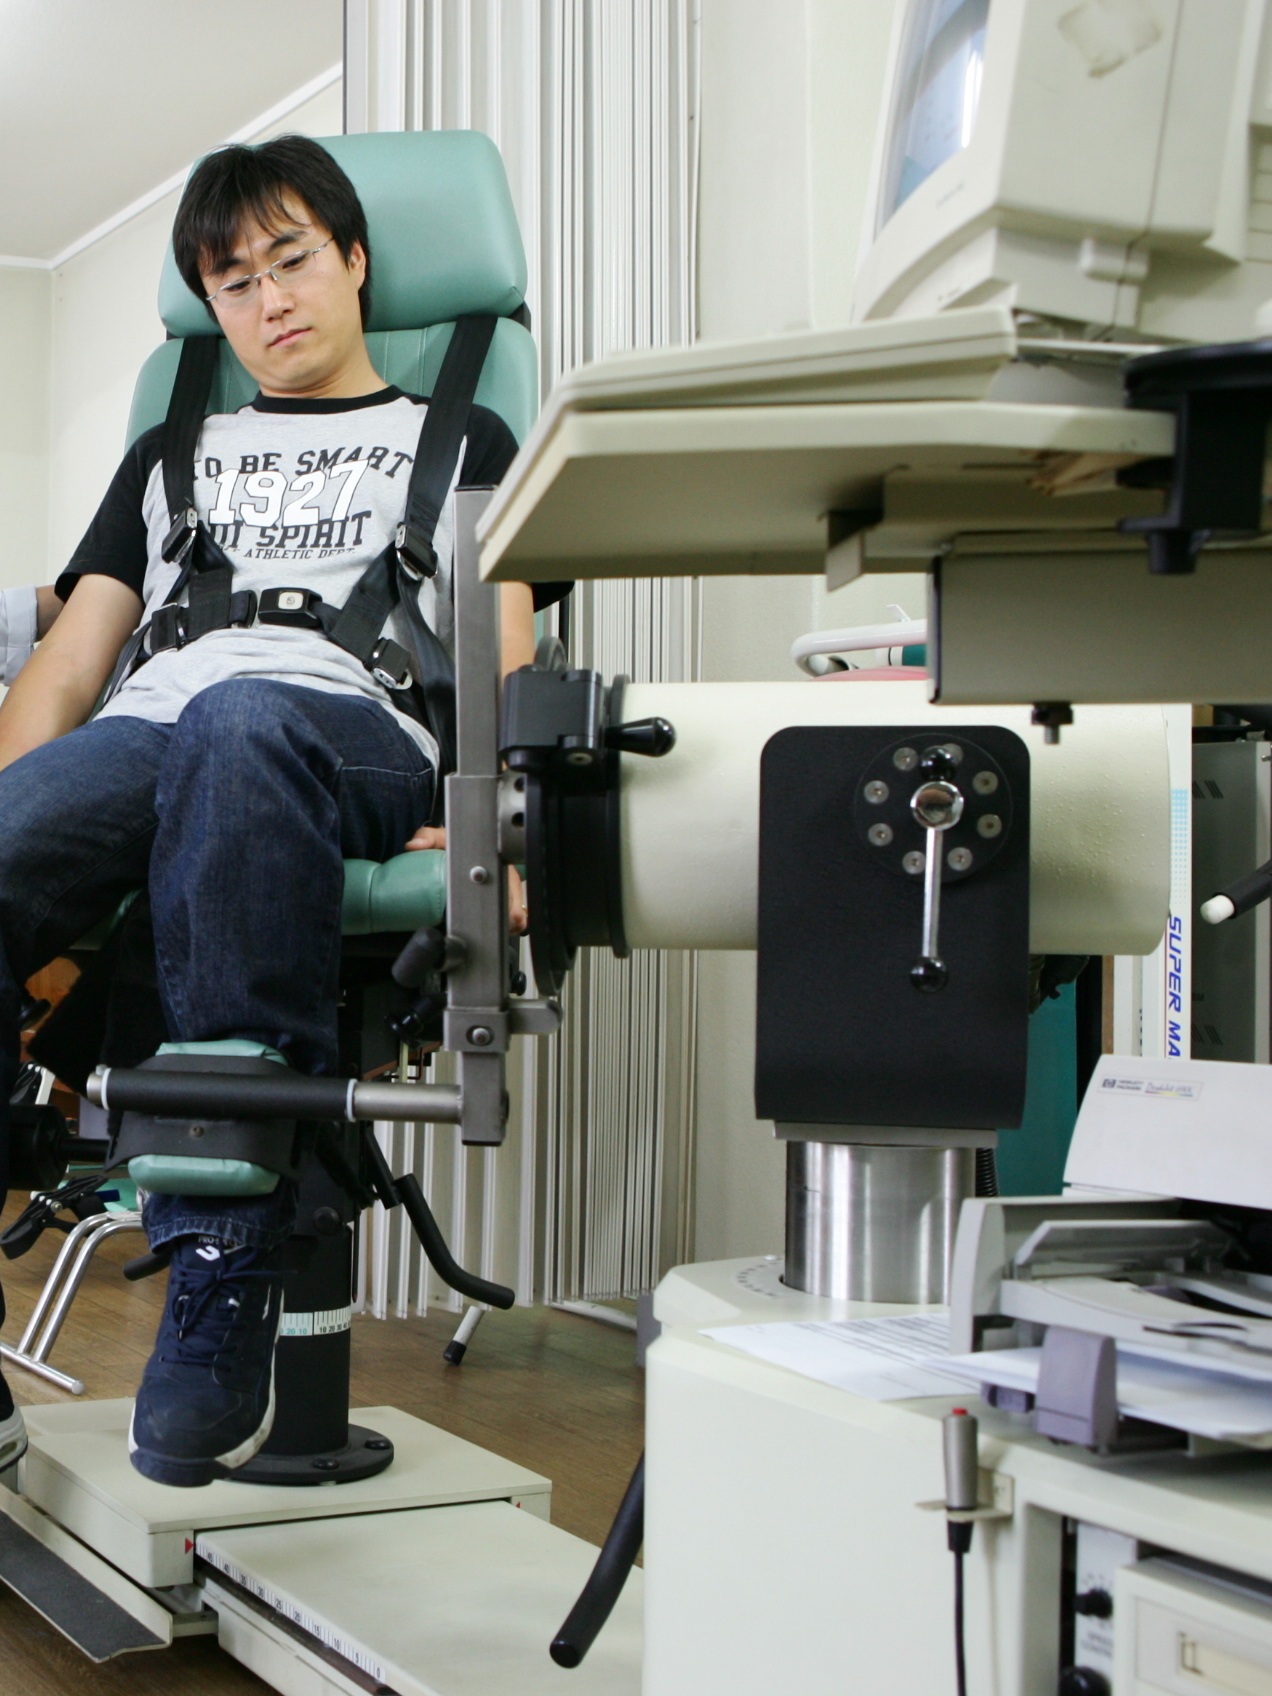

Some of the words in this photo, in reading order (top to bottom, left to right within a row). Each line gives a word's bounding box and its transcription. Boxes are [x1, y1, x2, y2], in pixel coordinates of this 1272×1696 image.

[240, 453, 282, 474] BE
[295, 446, 414, 478] SMART
[208, 459, 370, 527] 1927
[256, 510, 372, 549] SPIRIT
[243, 548, 314, 560] ATHLETIC
[1168, 916, 1182, 1013] SUPER
[1168, 1020, 1182, 1058] MA
[294, 1610, 301, 1622] 20
[314, 1625, 320, 1636] 15
[334, 1638, 340, 1650] 10
[355, 1652, 360, 1663] 5
[376, 1667, 381, 1679] 0
